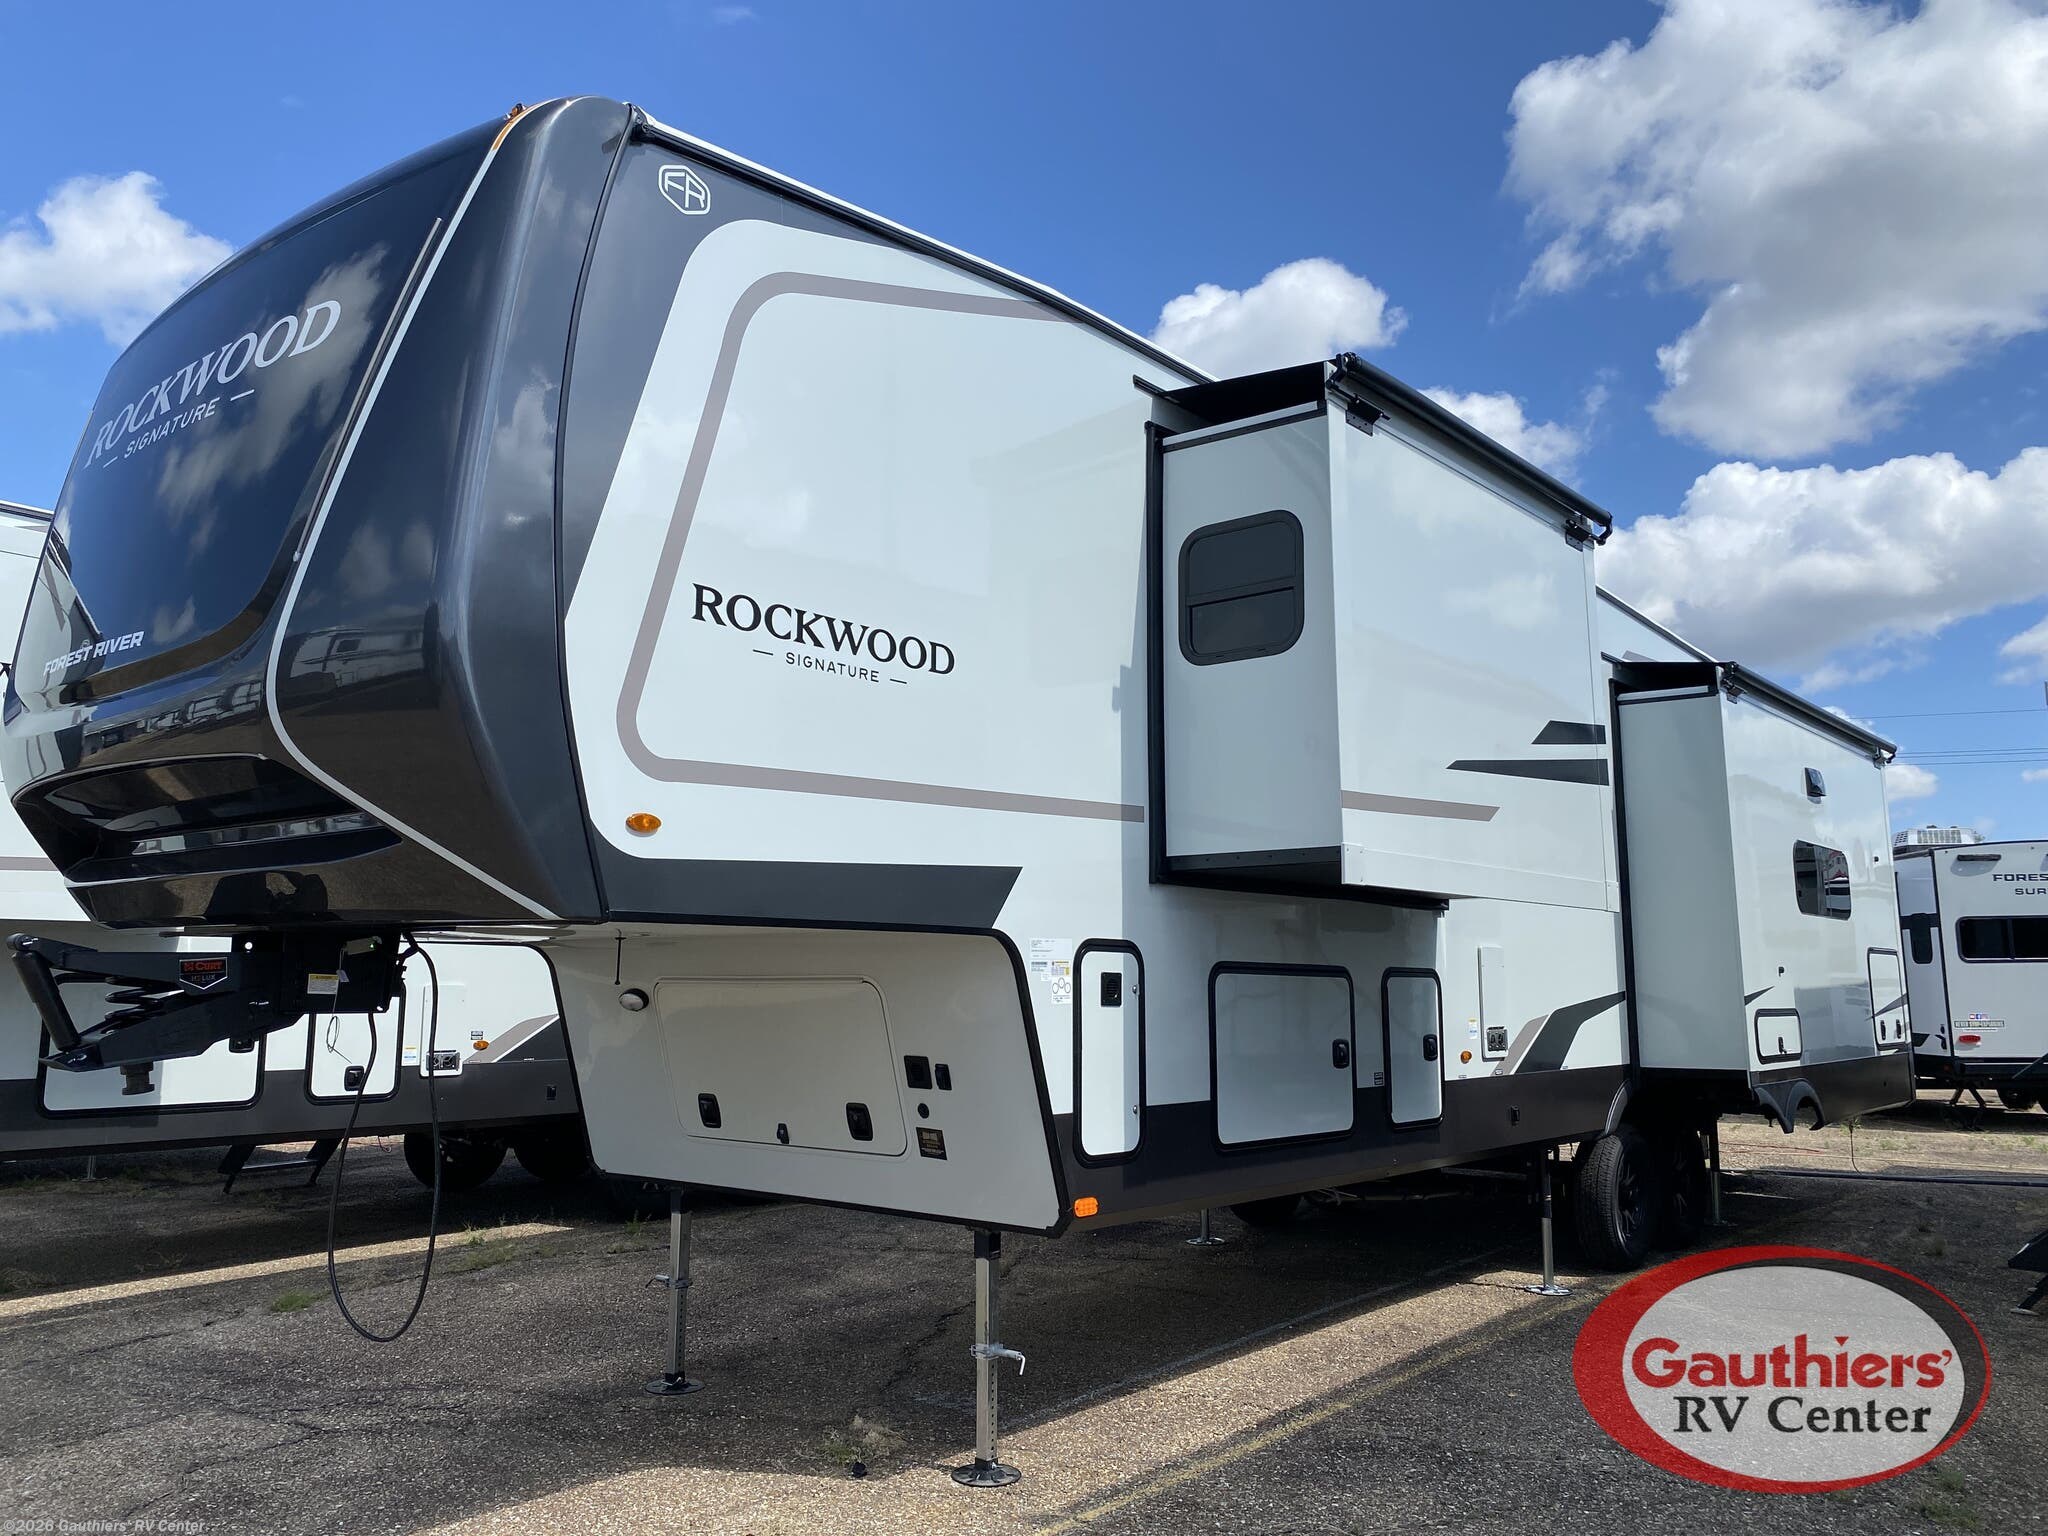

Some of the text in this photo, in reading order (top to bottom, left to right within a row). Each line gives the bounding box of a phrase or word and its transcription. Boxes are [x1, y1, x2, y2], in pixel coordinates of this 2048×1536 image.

[84, 299, 341, 470] ROCKWOOD
[123, 397, 221, 459] SIGNATURE
[43, 631, 145, 676] FOREST RIVER
[691, 582, 955, 675] ROCKWOOD
[785, 651, 880, 683] SIGNATURE
